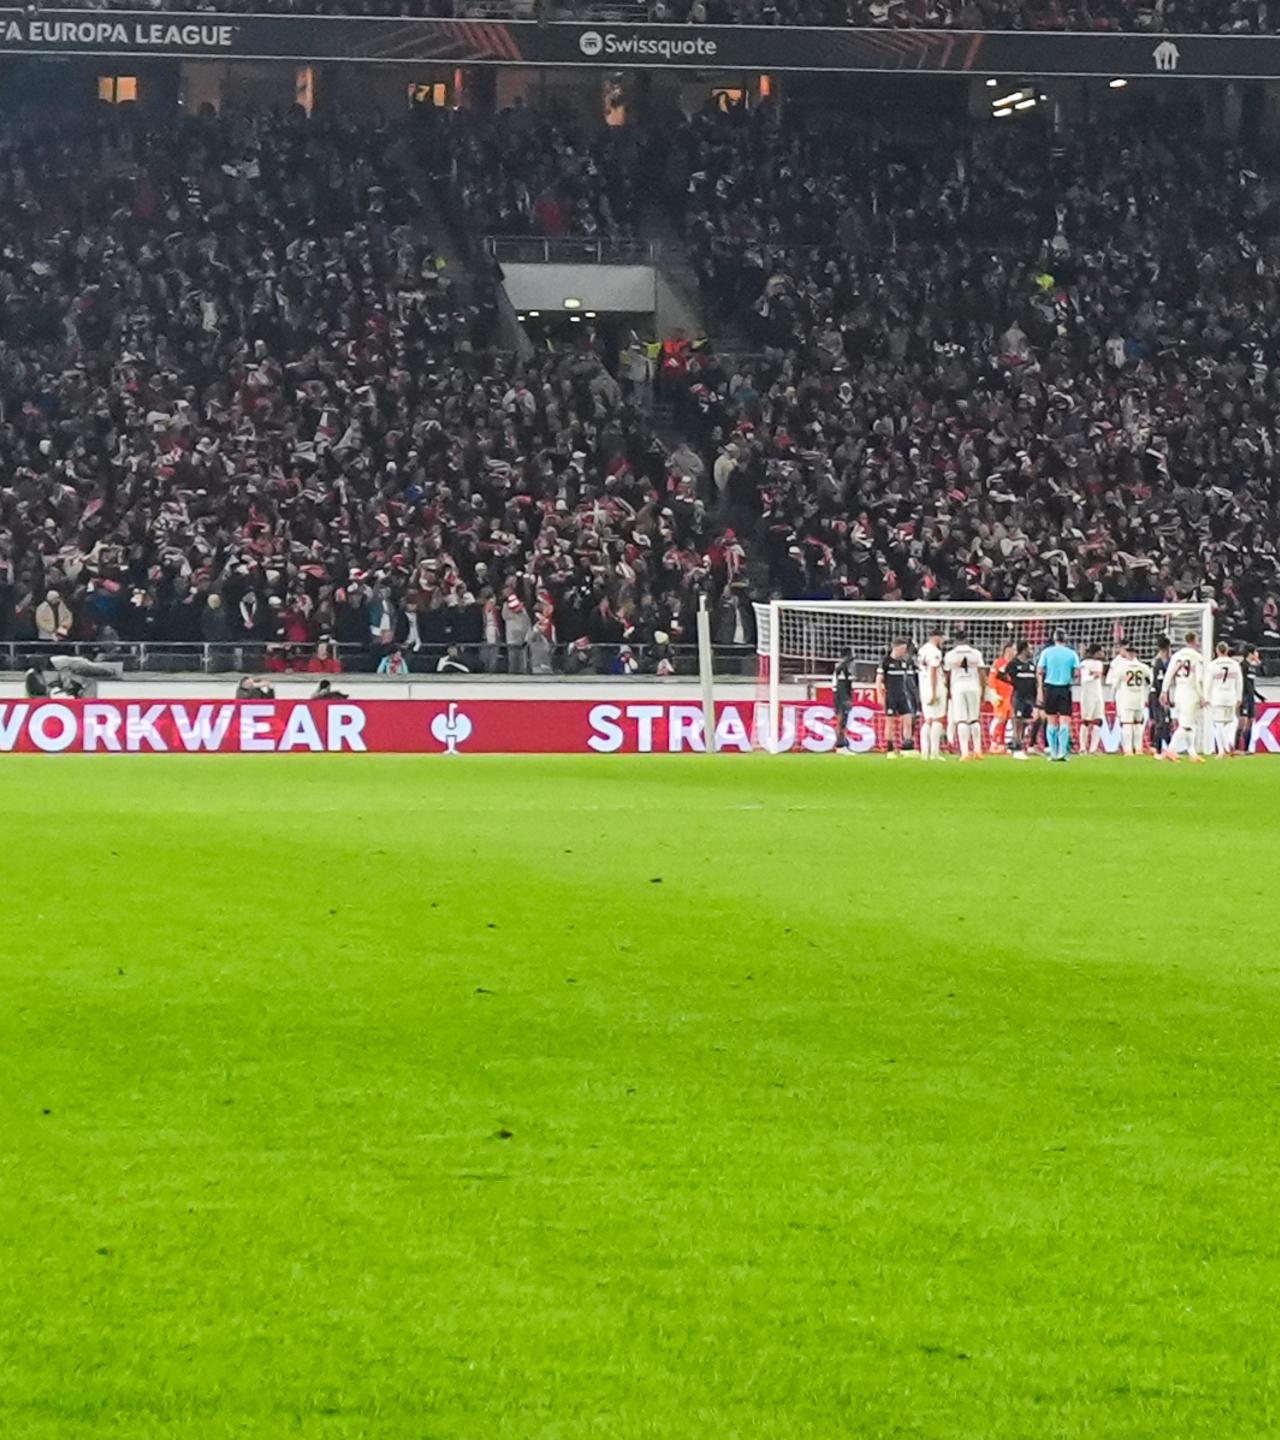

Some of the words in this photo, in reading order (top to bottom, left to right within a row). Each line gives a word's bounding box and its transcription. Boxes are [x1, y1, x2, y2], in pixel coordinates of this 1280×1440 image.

[29, 21, 129, 44] EUROPA
[135, 24, 233, 47] LEAGUE
[604, 33, 717, 60] Swissquote
[587, 704, 877, 753] STRAUSS
